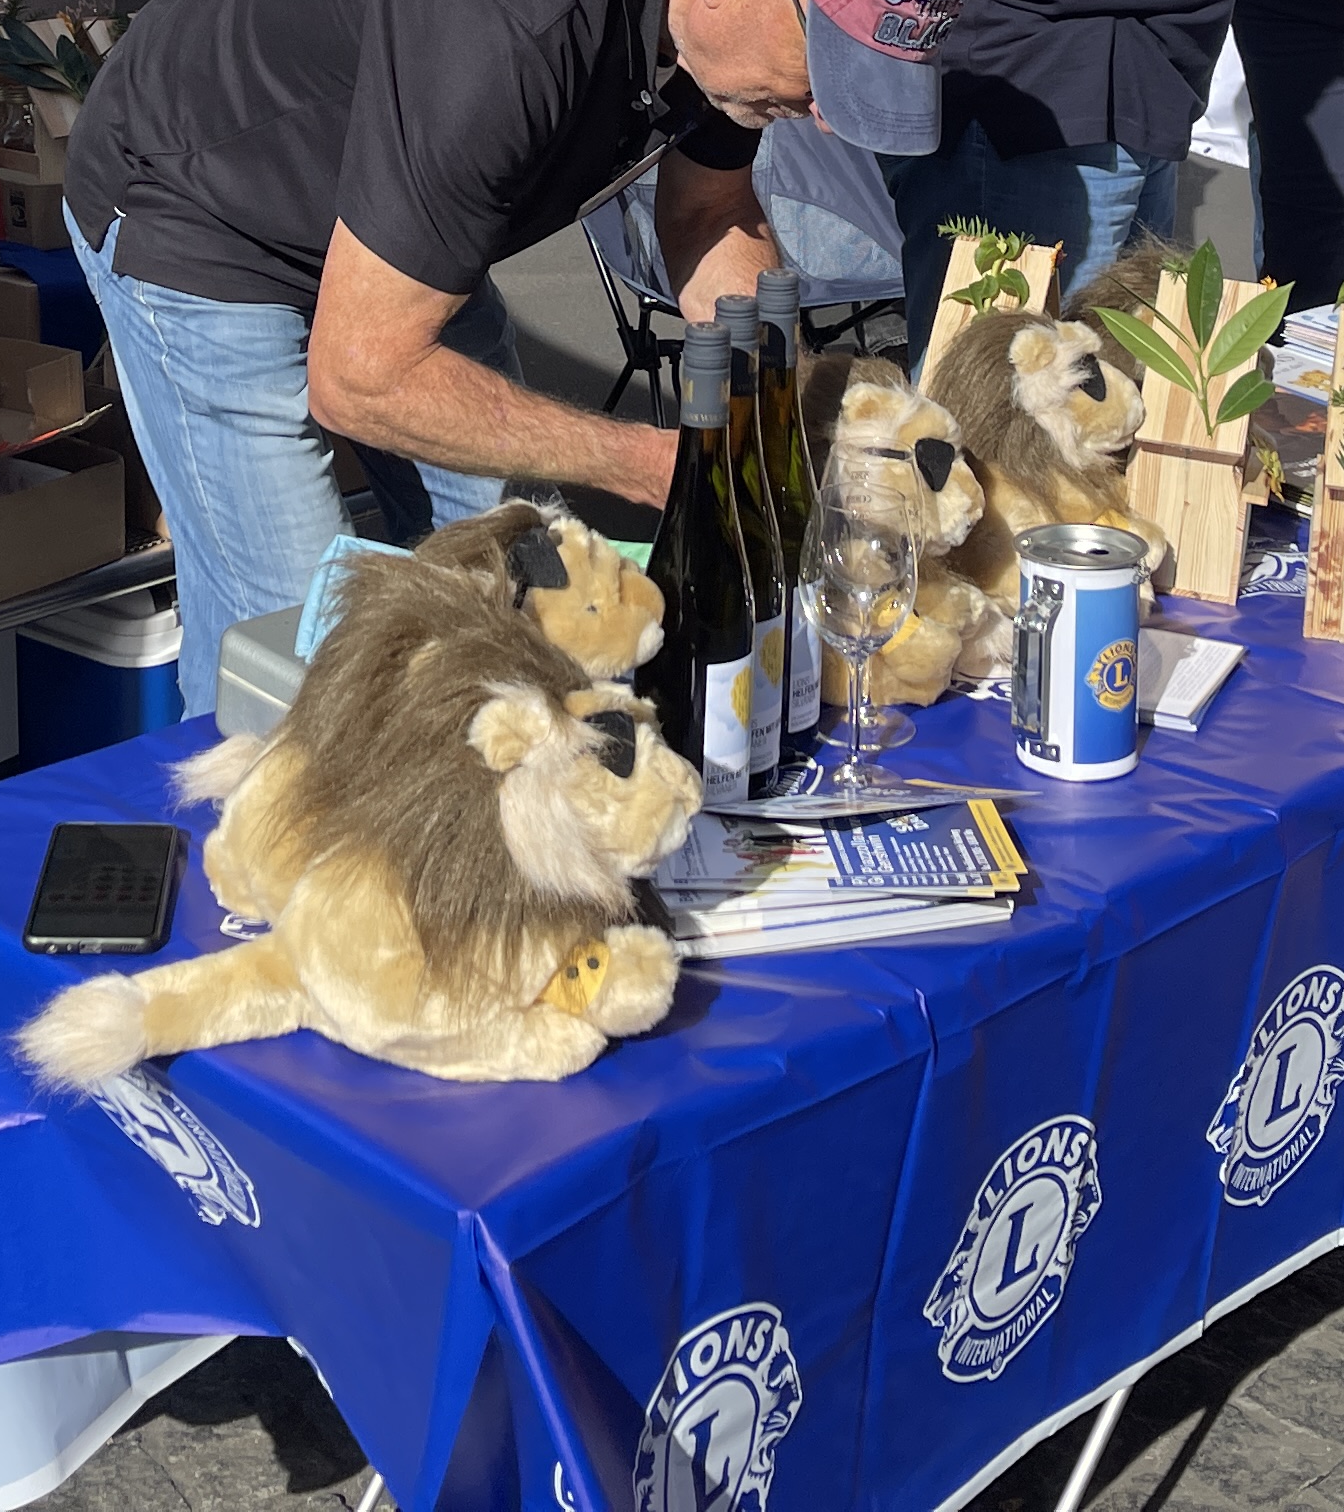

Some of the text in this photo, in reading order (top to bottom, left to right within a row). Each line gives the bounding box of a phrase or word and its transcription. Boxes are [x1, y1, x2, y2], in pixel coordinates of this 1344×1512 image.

[1114, 662, 1128, 687] L
[1259, 975, 1342, 1049] LIONS
[1264, 1043, 1302, 1127] L
[984, 1126, 1089, 1210] LIONS
[1230, 1126, 1314, 1192] INTERNATIONAL
[995, 1202, 1040, 1296] L
[955, 1287, 1055, 1367] INTERNATIONAL
[657, 1317, 772, 1424] LIONS
